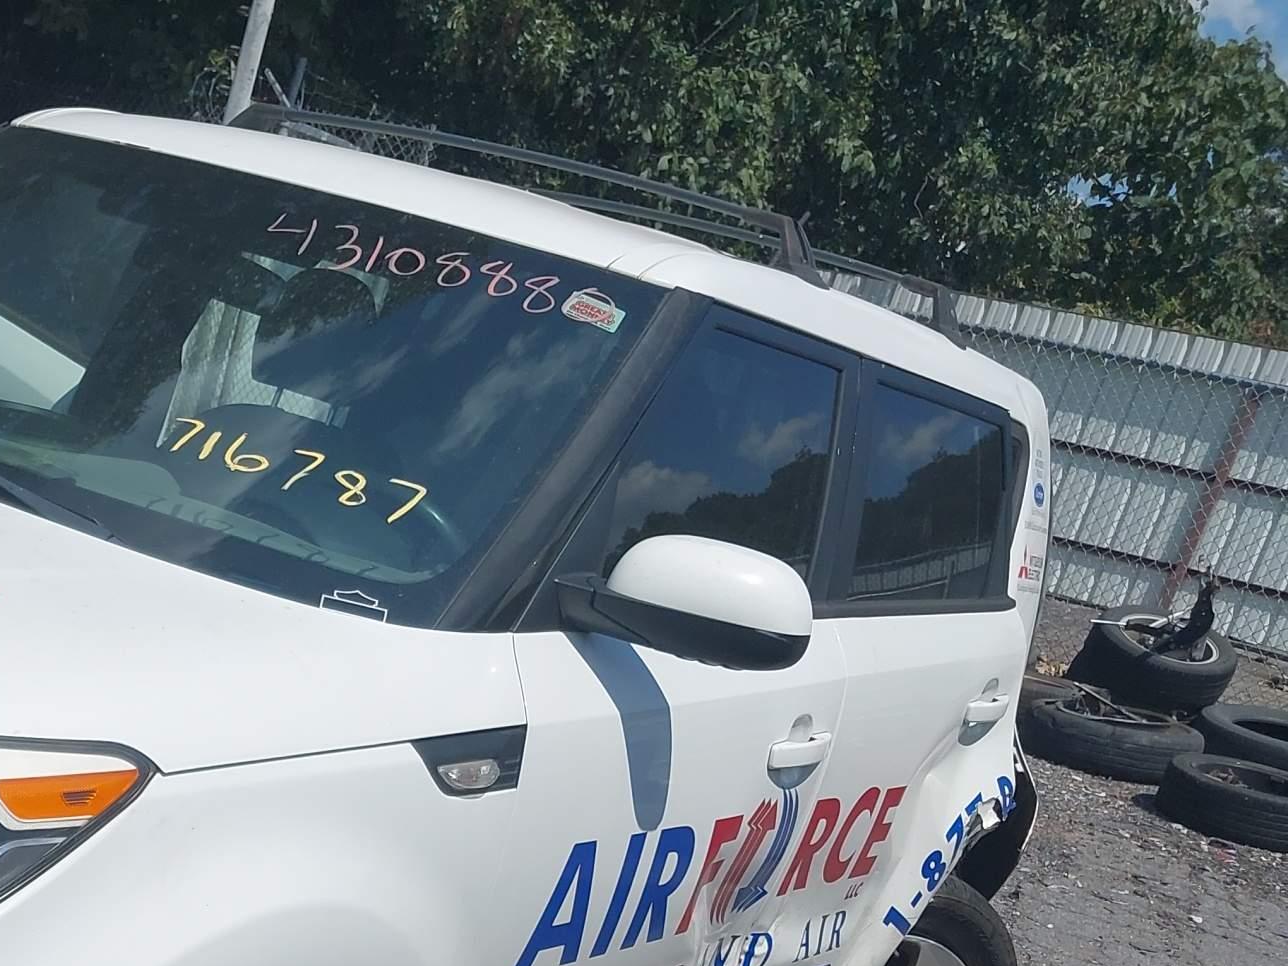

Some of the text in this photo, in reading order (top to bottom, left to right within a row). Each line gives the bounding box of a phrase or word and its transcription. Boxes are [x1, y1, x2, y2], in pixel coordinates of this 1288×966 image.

[170, 417, 427, 524] 716787
[844, 881, 864, 900] LLC
[791, 910, 848, 964] AIR
